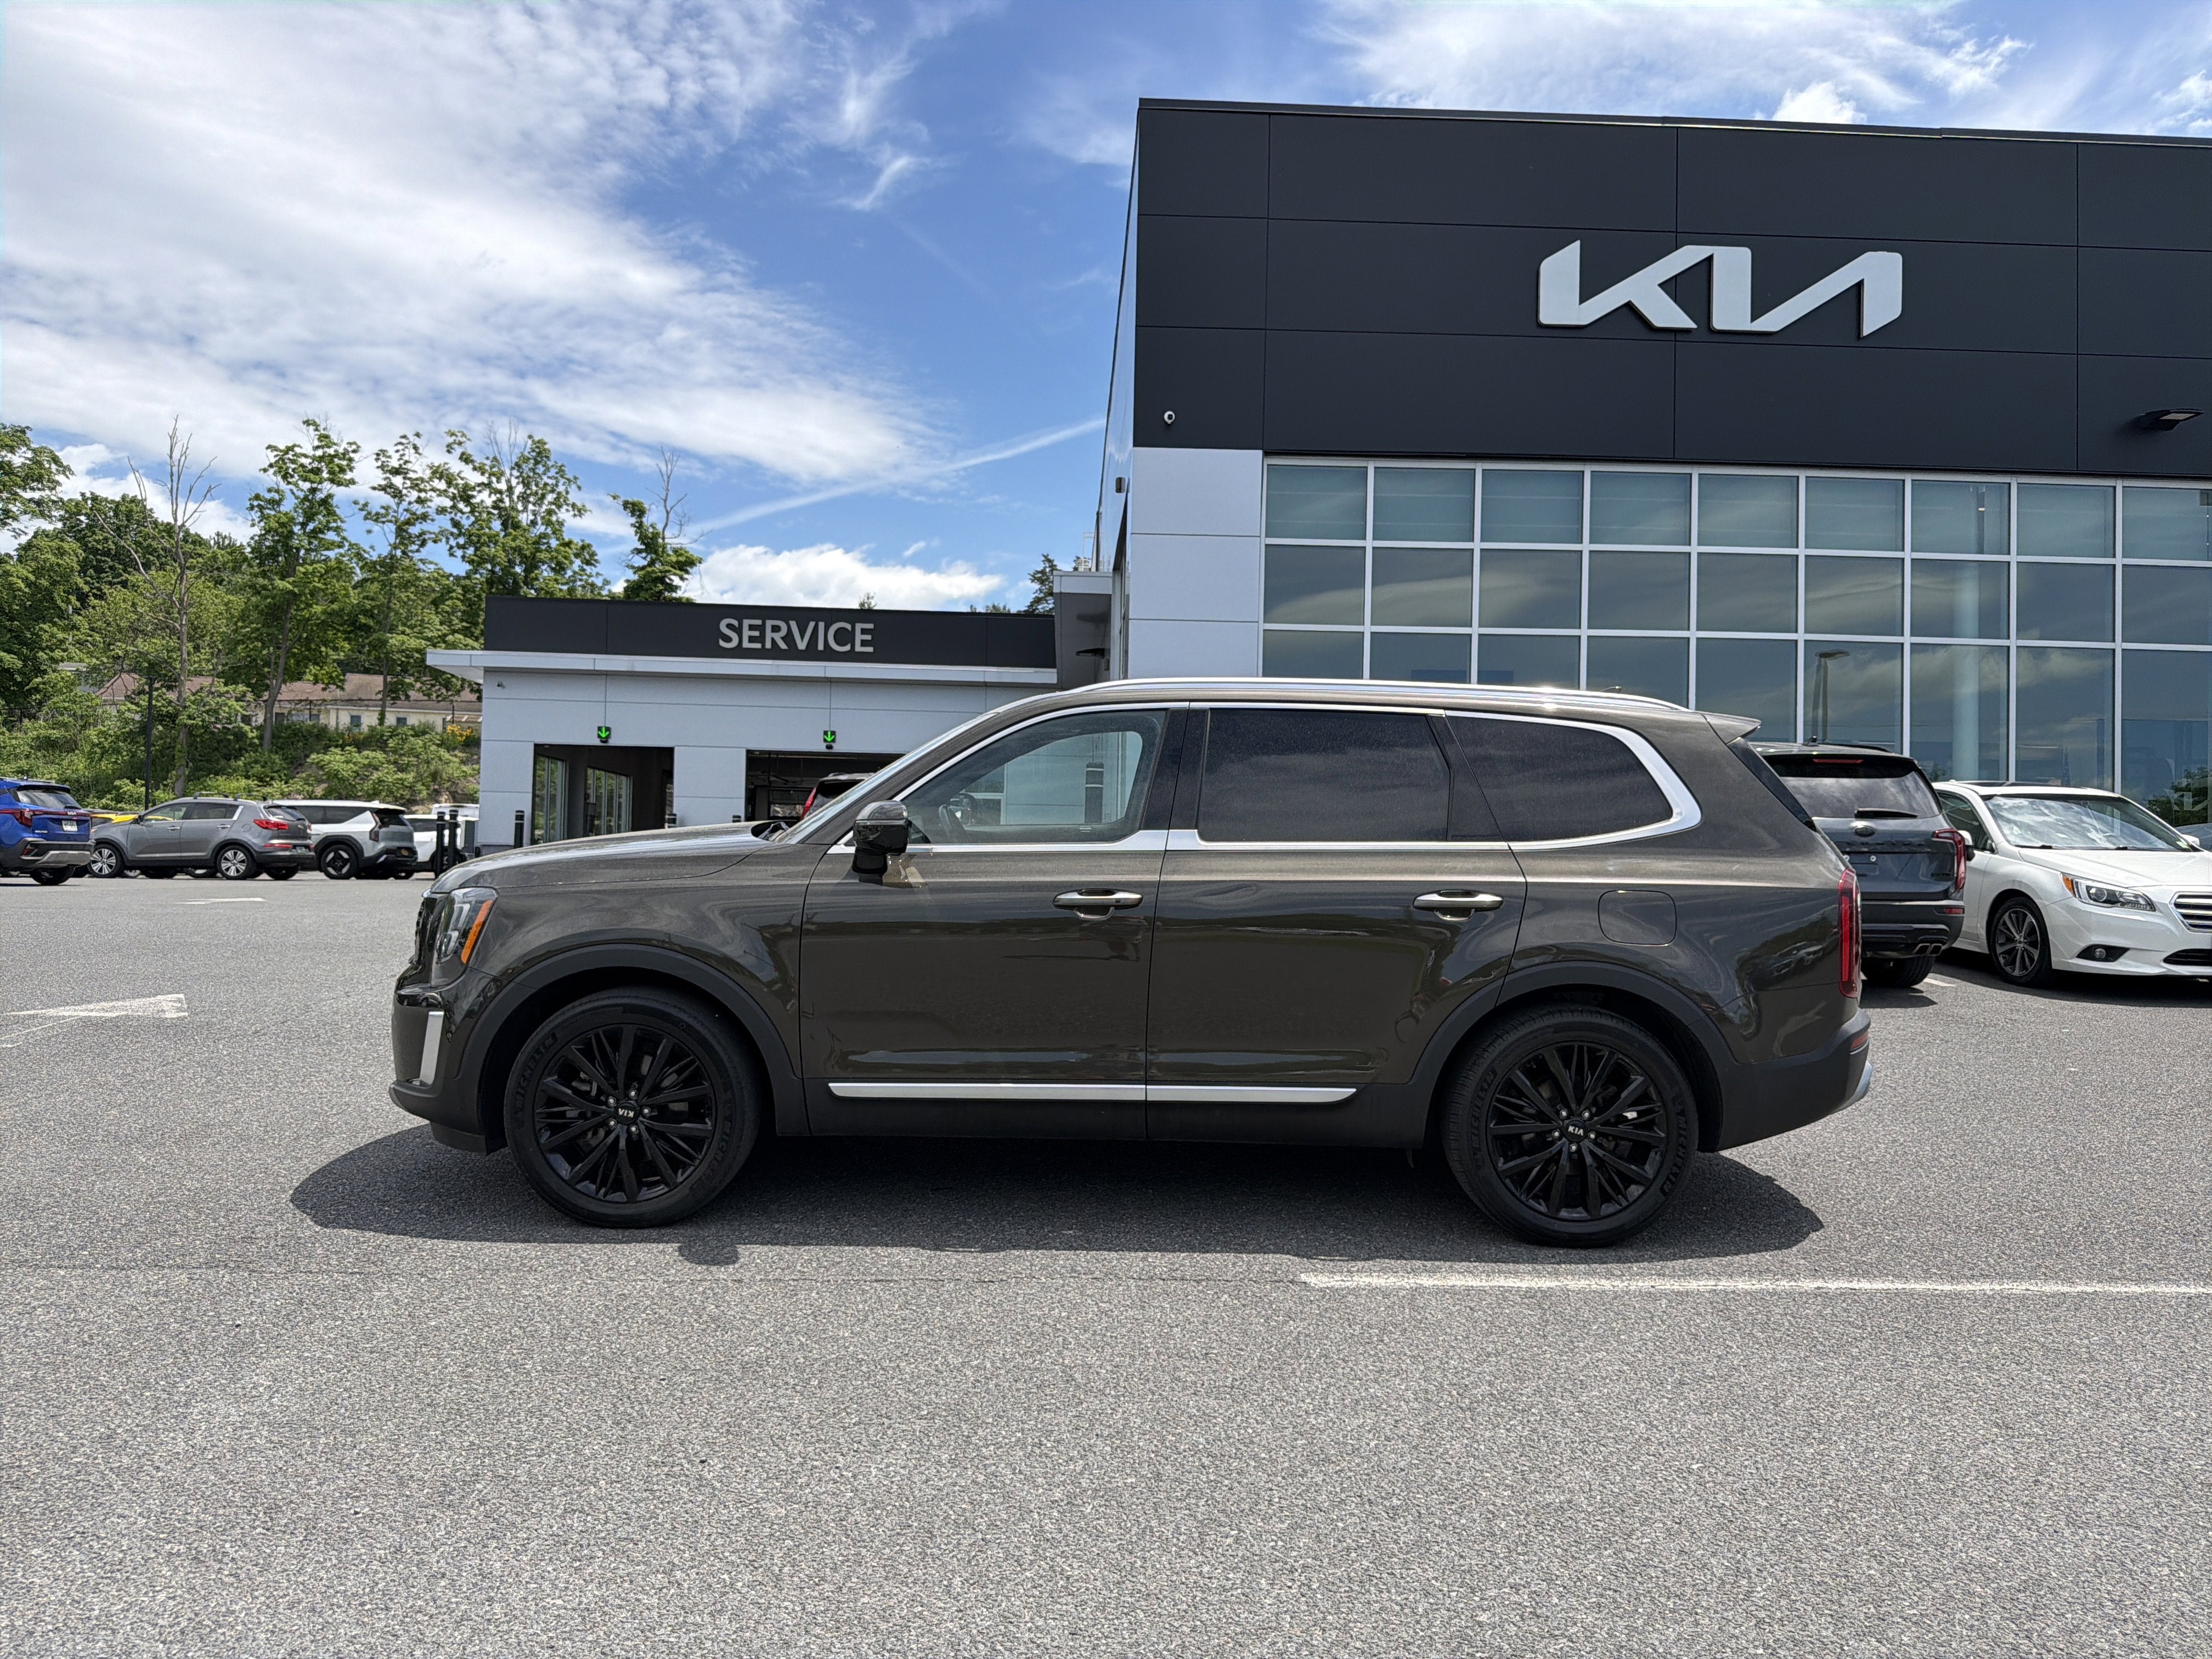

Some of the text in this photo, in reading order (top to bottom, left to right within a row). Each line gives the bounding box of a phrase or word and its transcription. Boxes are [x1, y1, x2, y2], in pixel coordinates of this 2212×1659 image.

[1538, 239, 1903, 338] KIA
[718, 618, 874, 653] SERVICE
[618, 1108, 635, 1118] KIA
[1568, 1125, 1584, 1136] KIA
[1662, 1115, 1687, 1193] MICHELIN
